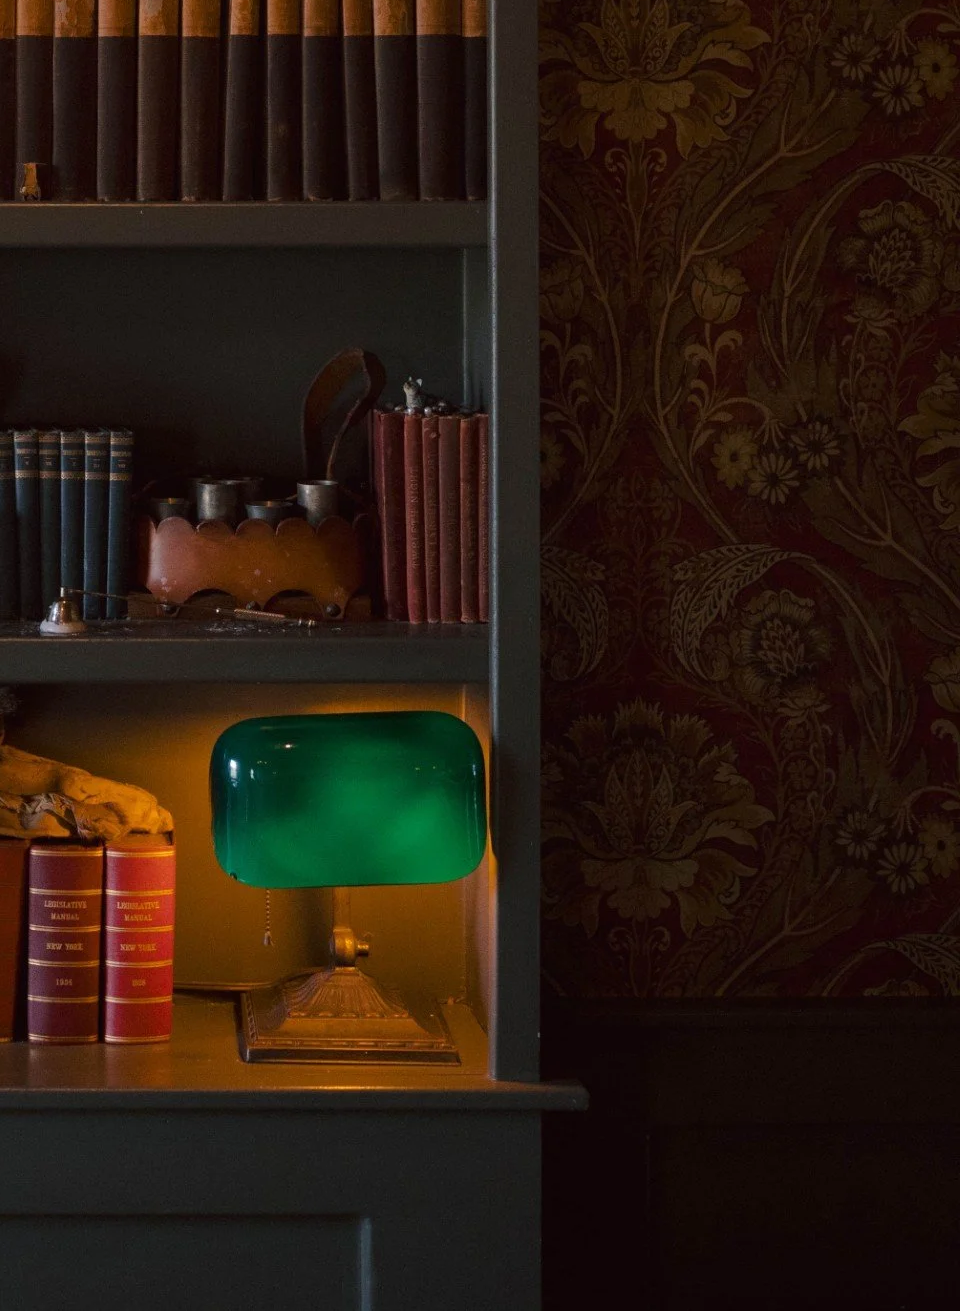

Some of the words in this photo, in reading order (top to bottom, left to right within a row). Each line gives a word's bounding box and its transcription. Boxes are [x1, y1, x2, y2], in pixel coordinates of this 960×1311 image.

[409, 466, 418, 504] NIGHT
[410, 509, 420, 569] TWELFTH
[44, 899, 88, 910] LEGISLATIVE
[116, 900, 161, 911] LEGISLATIVE
[50, 912, 80, 921] MANUAL
[123, 913, 153, 922] MANUAL
[46, 942, 62, 951] NEW
[64, 942, 84, 951] YORK
[119, 943, 136, 952] NEW
[137, 943, 157, 952] YORK
